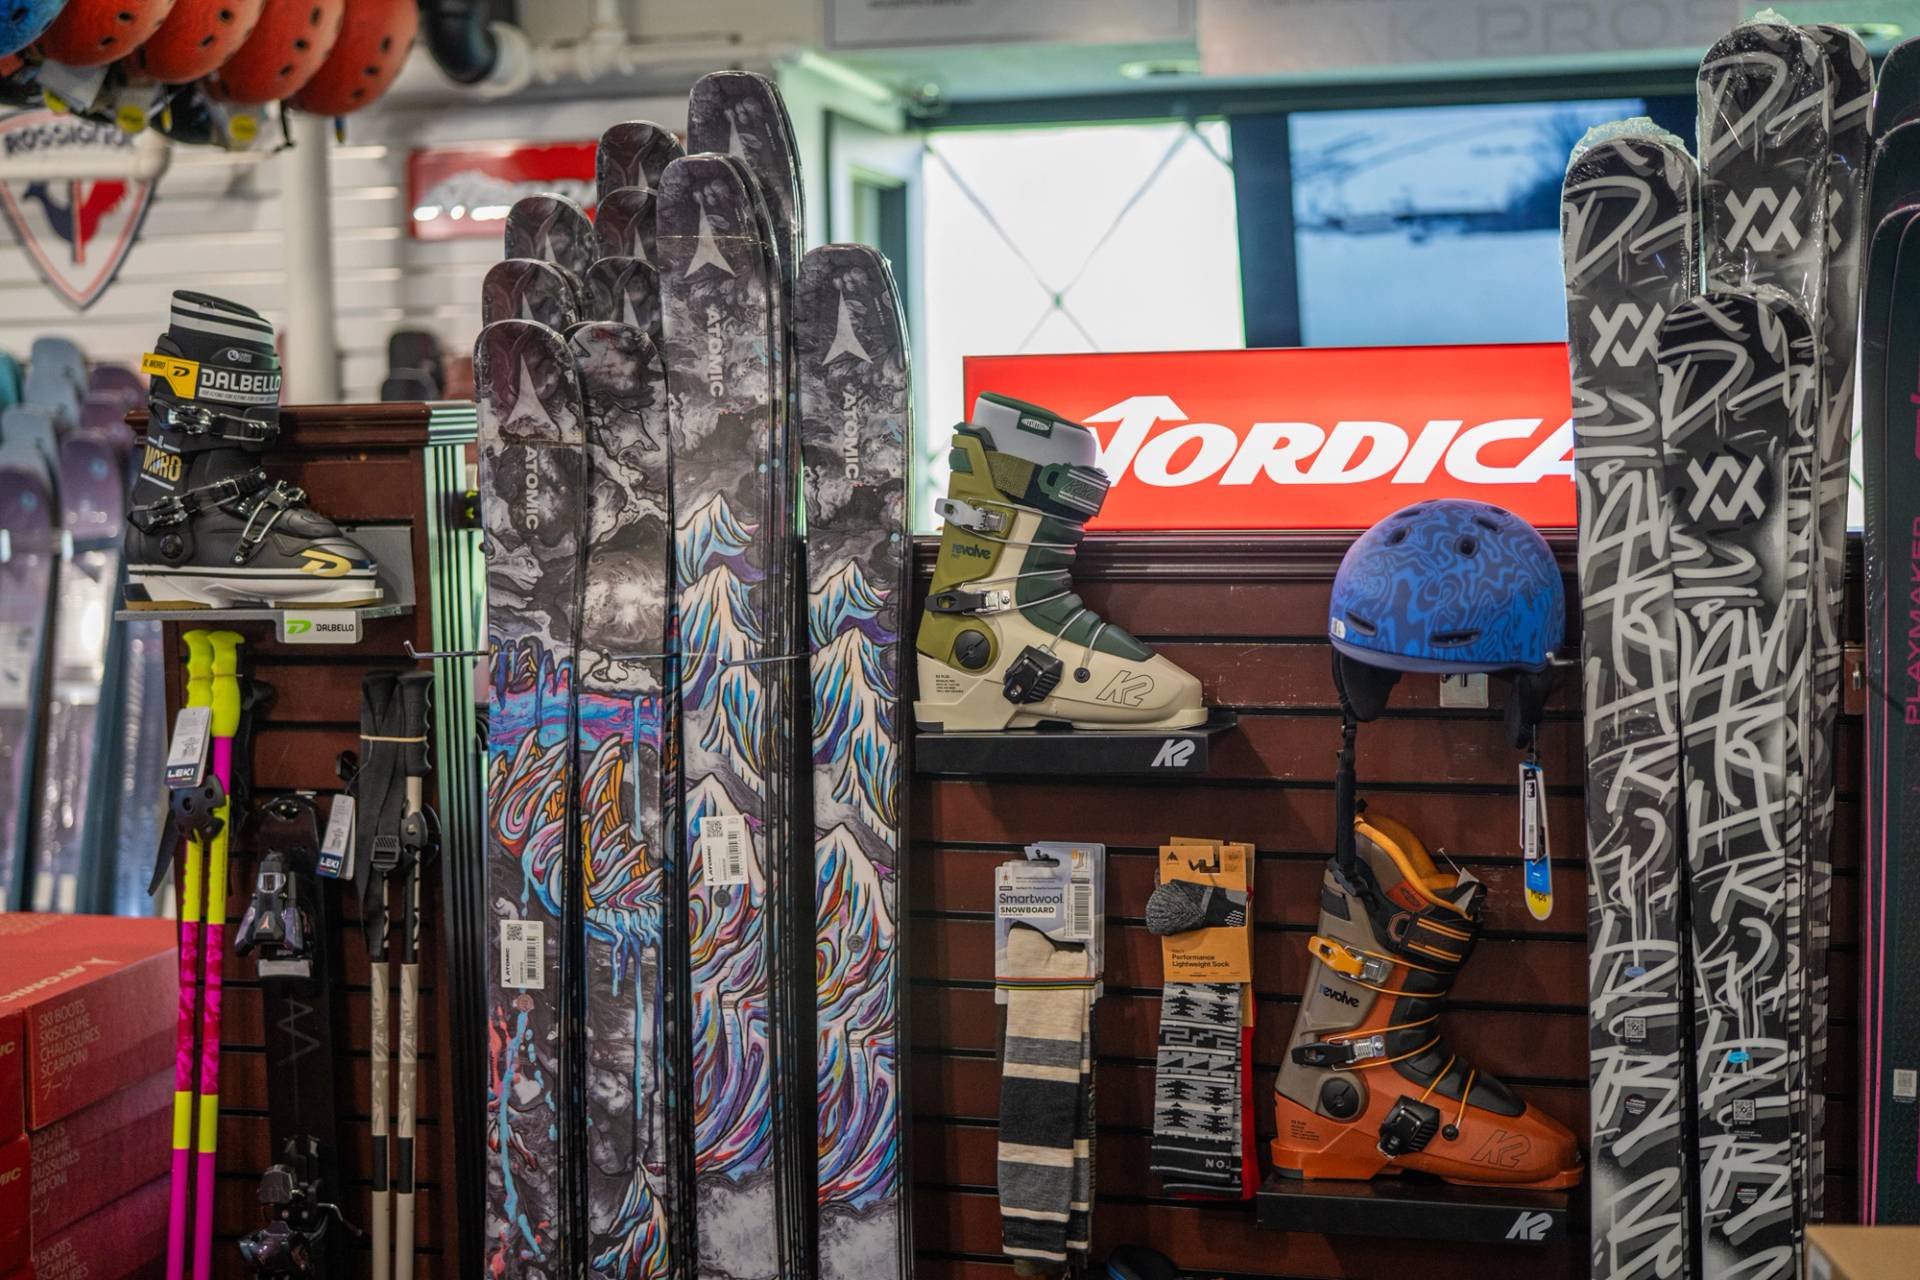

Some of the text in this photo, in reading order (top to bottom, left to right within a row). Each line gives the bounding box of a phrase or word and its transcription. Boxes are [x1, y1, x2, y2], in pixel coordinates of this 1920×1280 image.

[706, 304, 724, 397] ATOMIC
[201, 368, 281, 393] DALBELLO
[842, 391, 859, 479] ATOMIC
[525, 445, 539, 530] ATOMIC
[316, 623, 354, 632] DALBELLO
[1096, 670, 1154, 707] K2
[1151, 739, 1196, 767] K2
[167, 767, 194, 778] LEKI
[320, 857, 340, 869] LEKI
[999, 893, 1063, 904] Smartwool
[1000, 906, 1055, 914] SNOWBOARD
[1172, 961, 1211, 969] Lightweight
[54, 998, 86, 1023] BOOTS
[39, 1012, 91, 1046] SKISCHUHE
[39, 1025, 101, 1063] CHAUSSURES
[40, 1048, 88, 1080] SCARPONI
[1471, 1129, 1531, 1169] K2
[1505, 1211, 1553, 1240] K2
